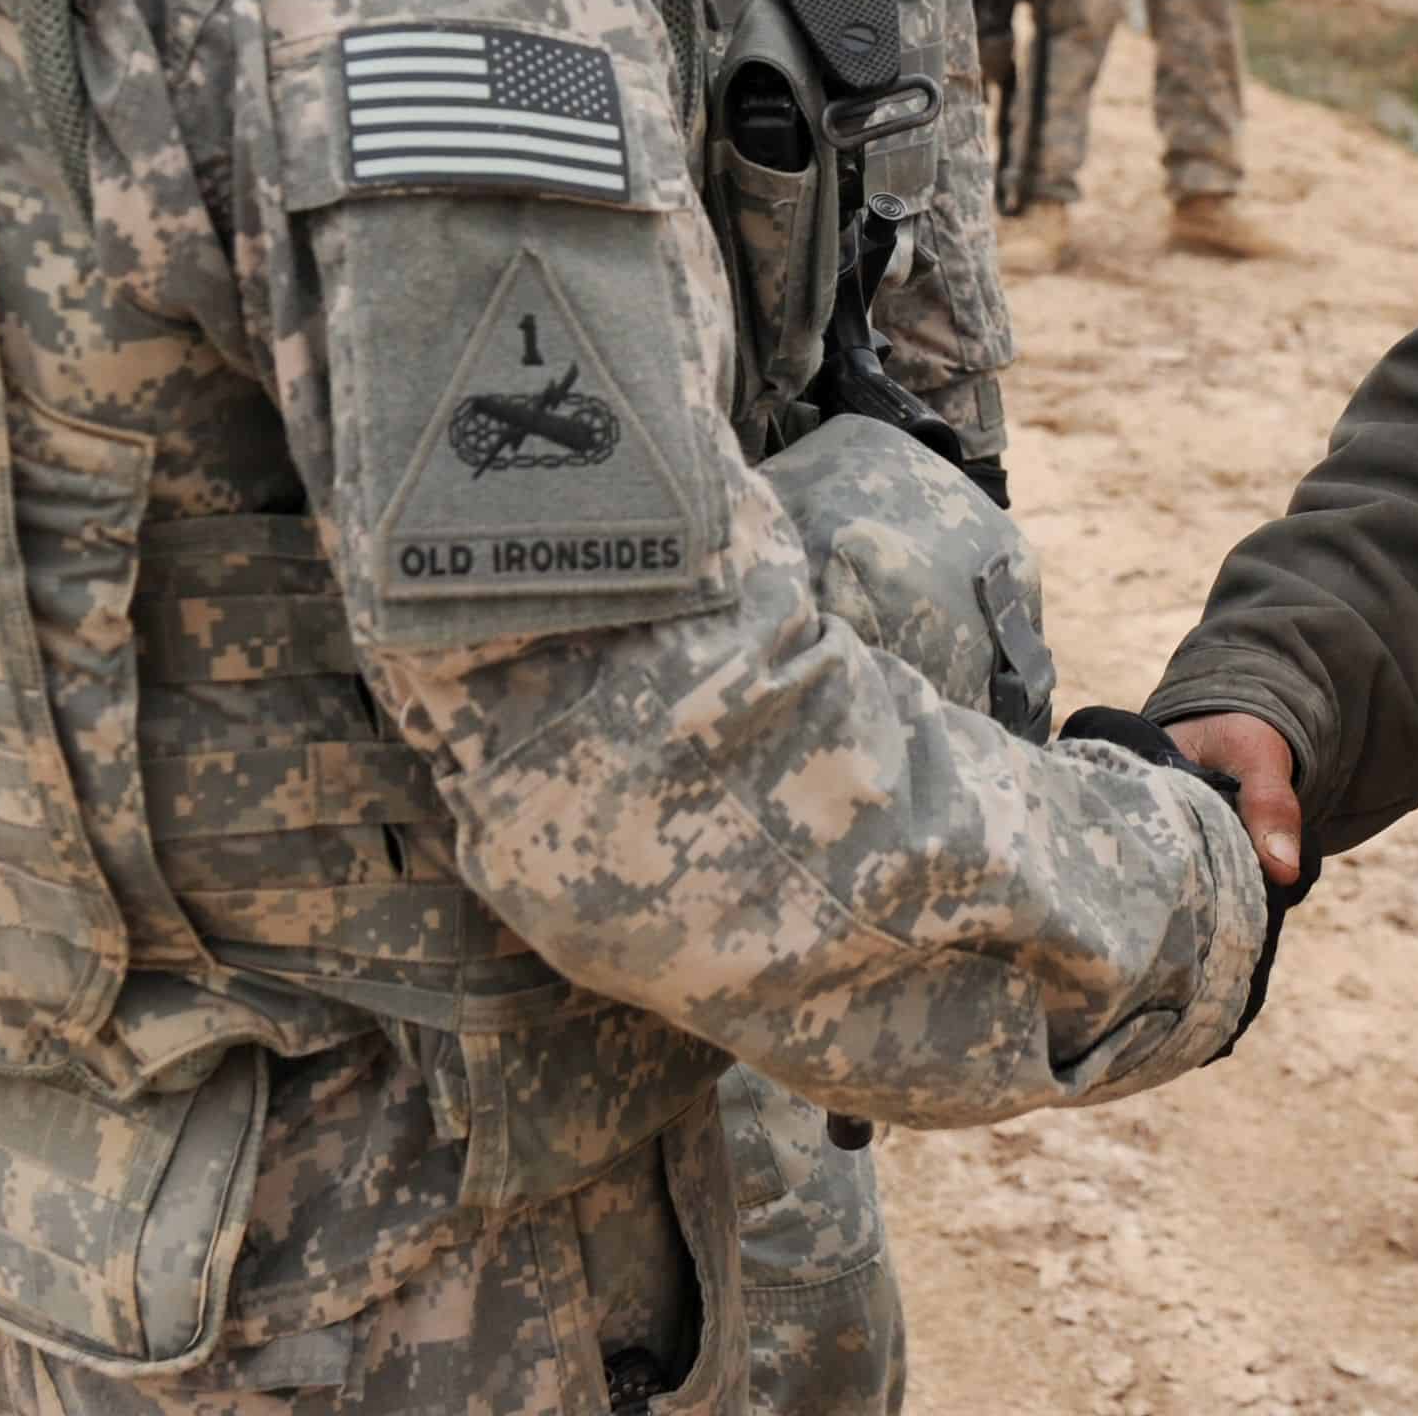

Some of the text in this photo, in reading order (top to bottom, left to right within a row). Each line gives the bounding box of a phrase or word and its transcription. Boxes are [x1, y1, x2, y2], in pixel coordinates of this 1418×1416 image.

[517, 313, 545, 367] 1
[399, 537, 681, 577] OLD IRONSIDES
